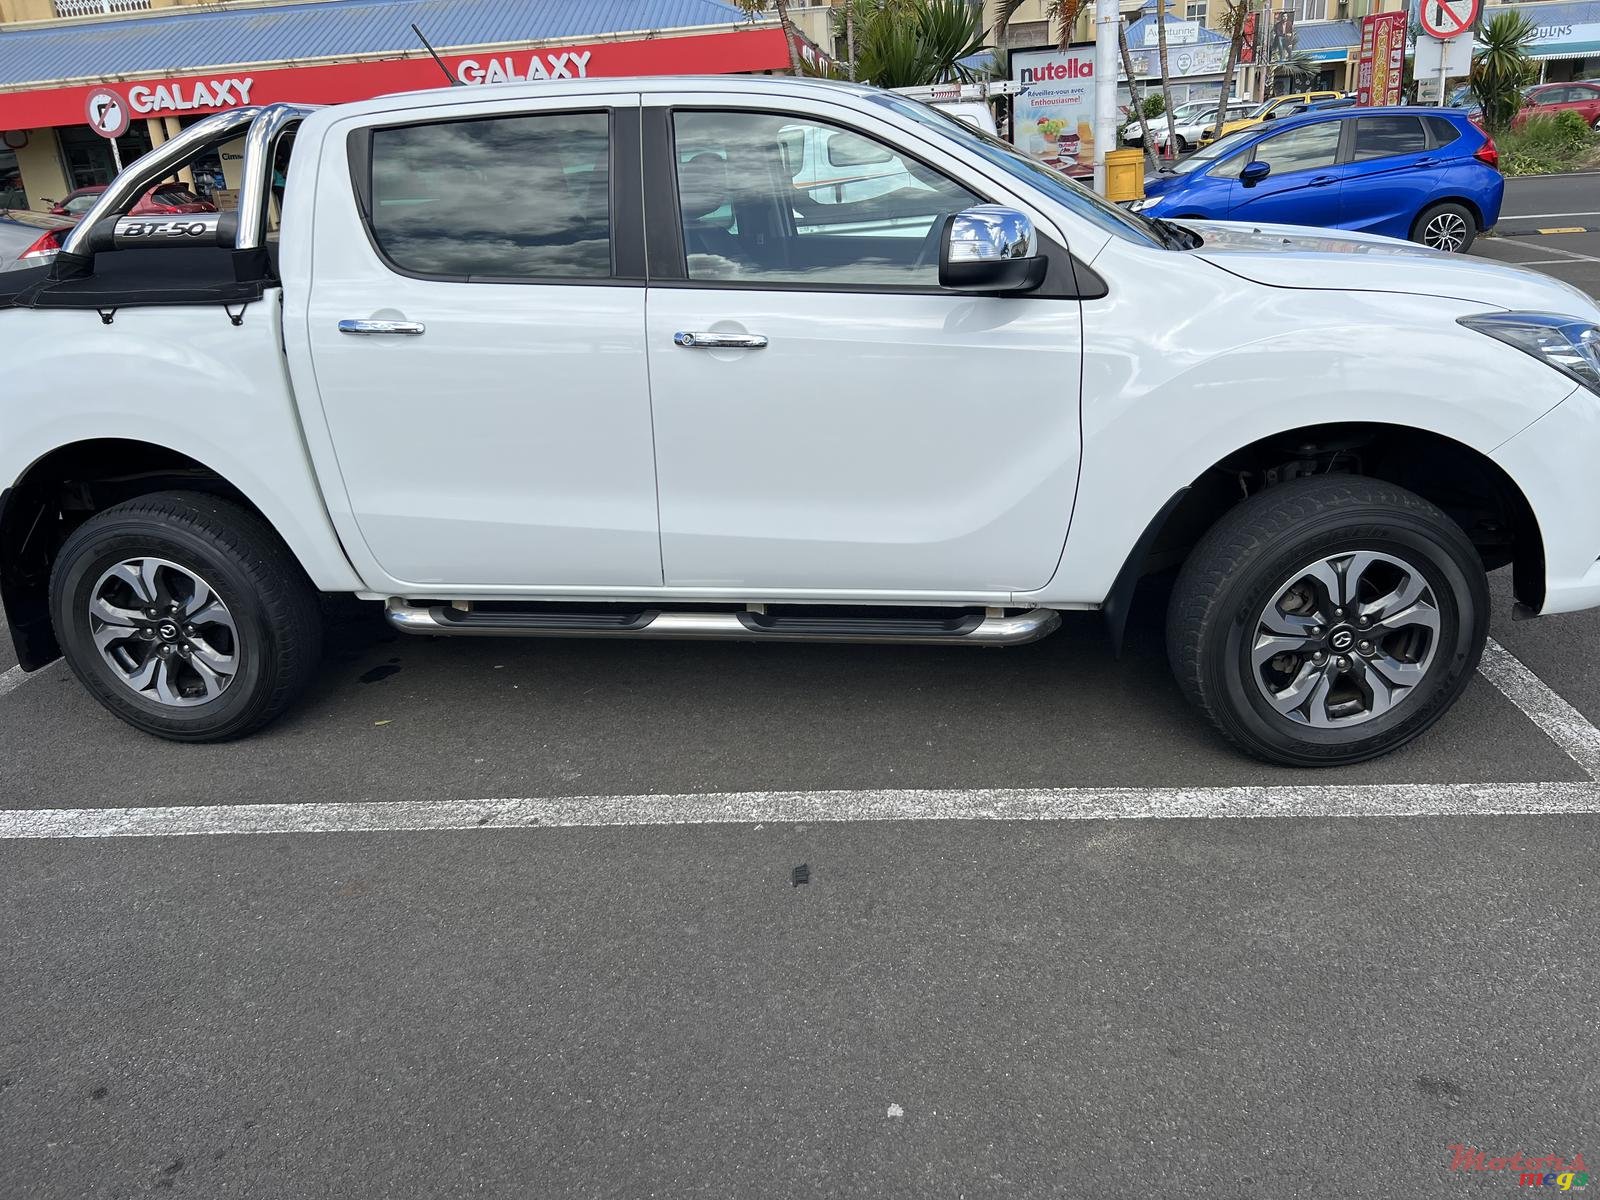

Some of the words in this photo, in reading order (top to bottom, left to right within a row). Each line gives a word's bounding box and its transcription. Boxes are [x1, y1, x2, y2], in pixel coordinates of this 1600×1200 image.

[457, 51, 591, 85] GALAXY
[1021, 58, 1093, 83] nutella
[128, 77, 253, 113] GALAXY
[1027, 89, 1069, 97] Réveillez-vous
[1031, 96, 1081, 106] Enthousiasme!
[123, 222, 207, 237] BT-50
